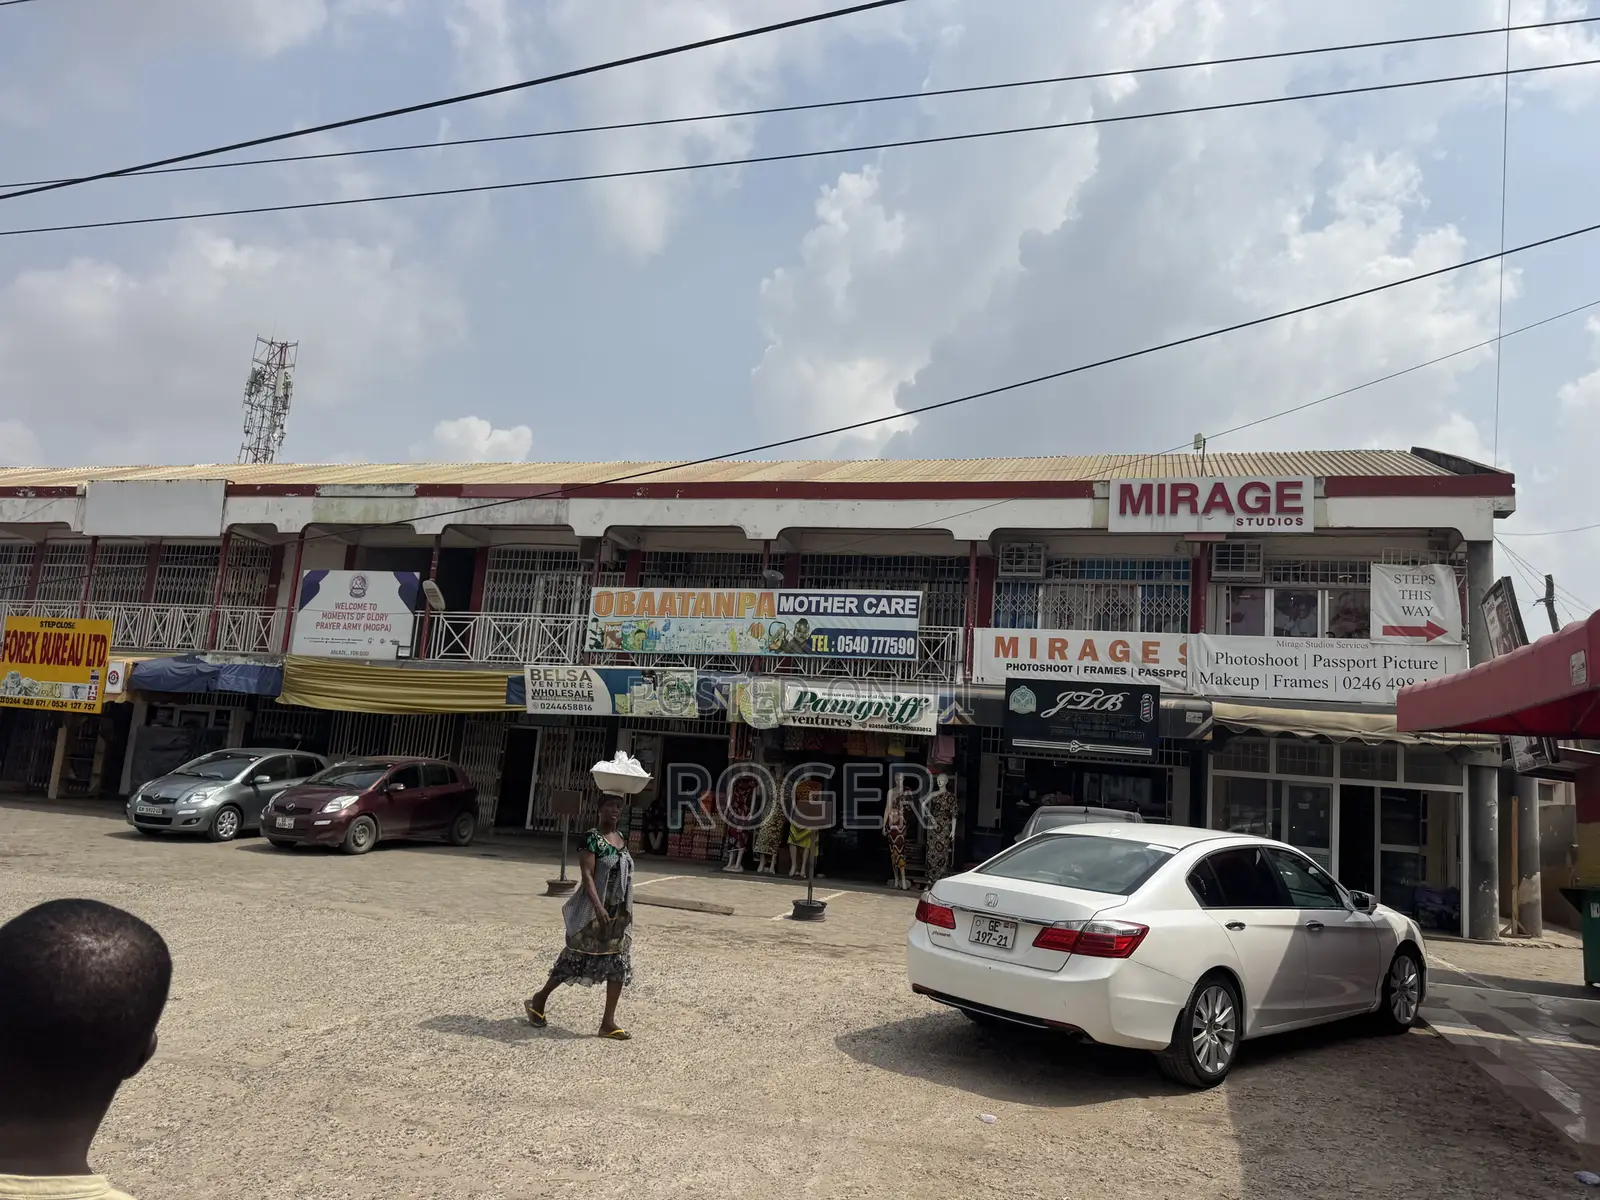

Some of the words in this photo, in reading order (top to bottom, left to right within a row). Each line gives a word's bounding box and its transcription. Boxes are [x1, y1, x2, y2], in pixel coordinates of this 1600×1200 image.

[1119, 481, 1304, 516] MIRAGE
[1236, 517, 1304, 527] STUDIOS
[1394, 574, 1436, 585] STEPS
[1399, 589, 1432, 601] THIS
[334, 602, 367, 611] WELCOME
[369, 602, 377, 611] TO
[593, 591, 777, 618] OBAATANPA
[779, 595, 859, 613] MOTHER
[863, 597, 917, 615] CARE
[1401, 605, 1434, 617] WAY
[321, 612, 354, 621] MOMENTS
[355, 613, 365, 621] OF
[366, 613, 389, 622] GLORY
[315, 622, 341, 630] PRAYER
[342, 623, 362, 631] ARMY
[363, 623, 392, 632] (MOGPA)
[2, 630, 40, 665] FOREX
[39, 632, 86, 667] BUREAU
[837, 635, 868, 653] 0540
[871, 636, 914, 655] 777590
[994, 636, 1160, 664] MIRAGE
[1276, 640, 1304, 650] Mirage
[1305, 640, 1335, 649] Studios
[1336, 641, 1369, 650] Services
[1005, 662, 1073, 673] PHOTOSHOOT
[1084, 665, 1127, 675] FRAMES
[1214, 652, 1299, 667] Photoshoot
[1312, 654, 1378, 673] Passport
[1383, 655, 1438, 670] Picture
[530, 668, 592, 682] BELSA
[1199, 671, 1260, 690] Makeup
[1272, 673, 1329, 689] Frames
[1343, 676, 1381, 691] 0246
[531, 681, 593, 689] VENTURES
[531, 688, 593, 698] WHOLESALE
[540, 702, 593, 711] 0244658816
[792, 690, 929, 724] Pamgriff
[791, 714, 853, 727] ventures
[988, 920, 1002, 933] GE
[975, 930, 1008, 947] 197-21
